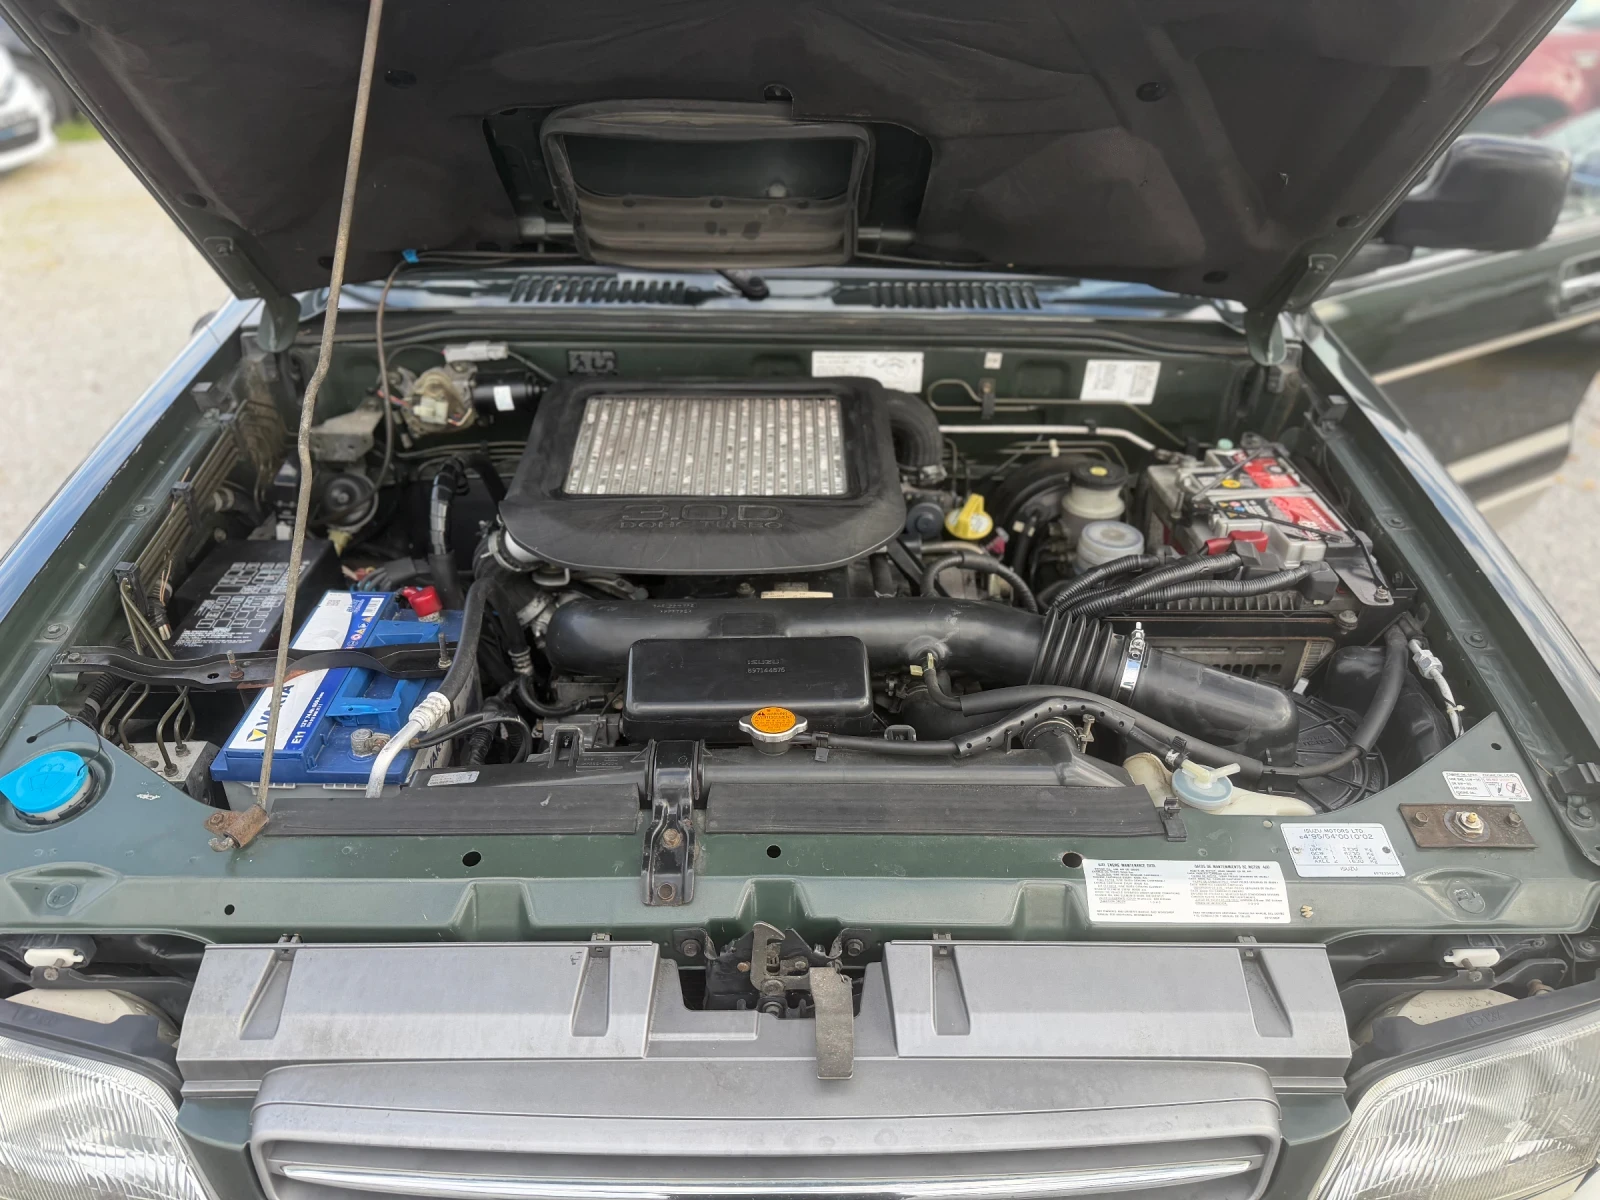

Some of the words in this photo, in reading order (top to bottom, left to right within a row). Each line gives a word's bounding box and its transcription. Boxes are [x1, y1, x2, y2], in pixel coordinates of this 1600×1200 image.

[620, 521, 690, 529] DOHC
[701, 521, 783, 529] TURBO
[291, 731, 307, 744] E11
